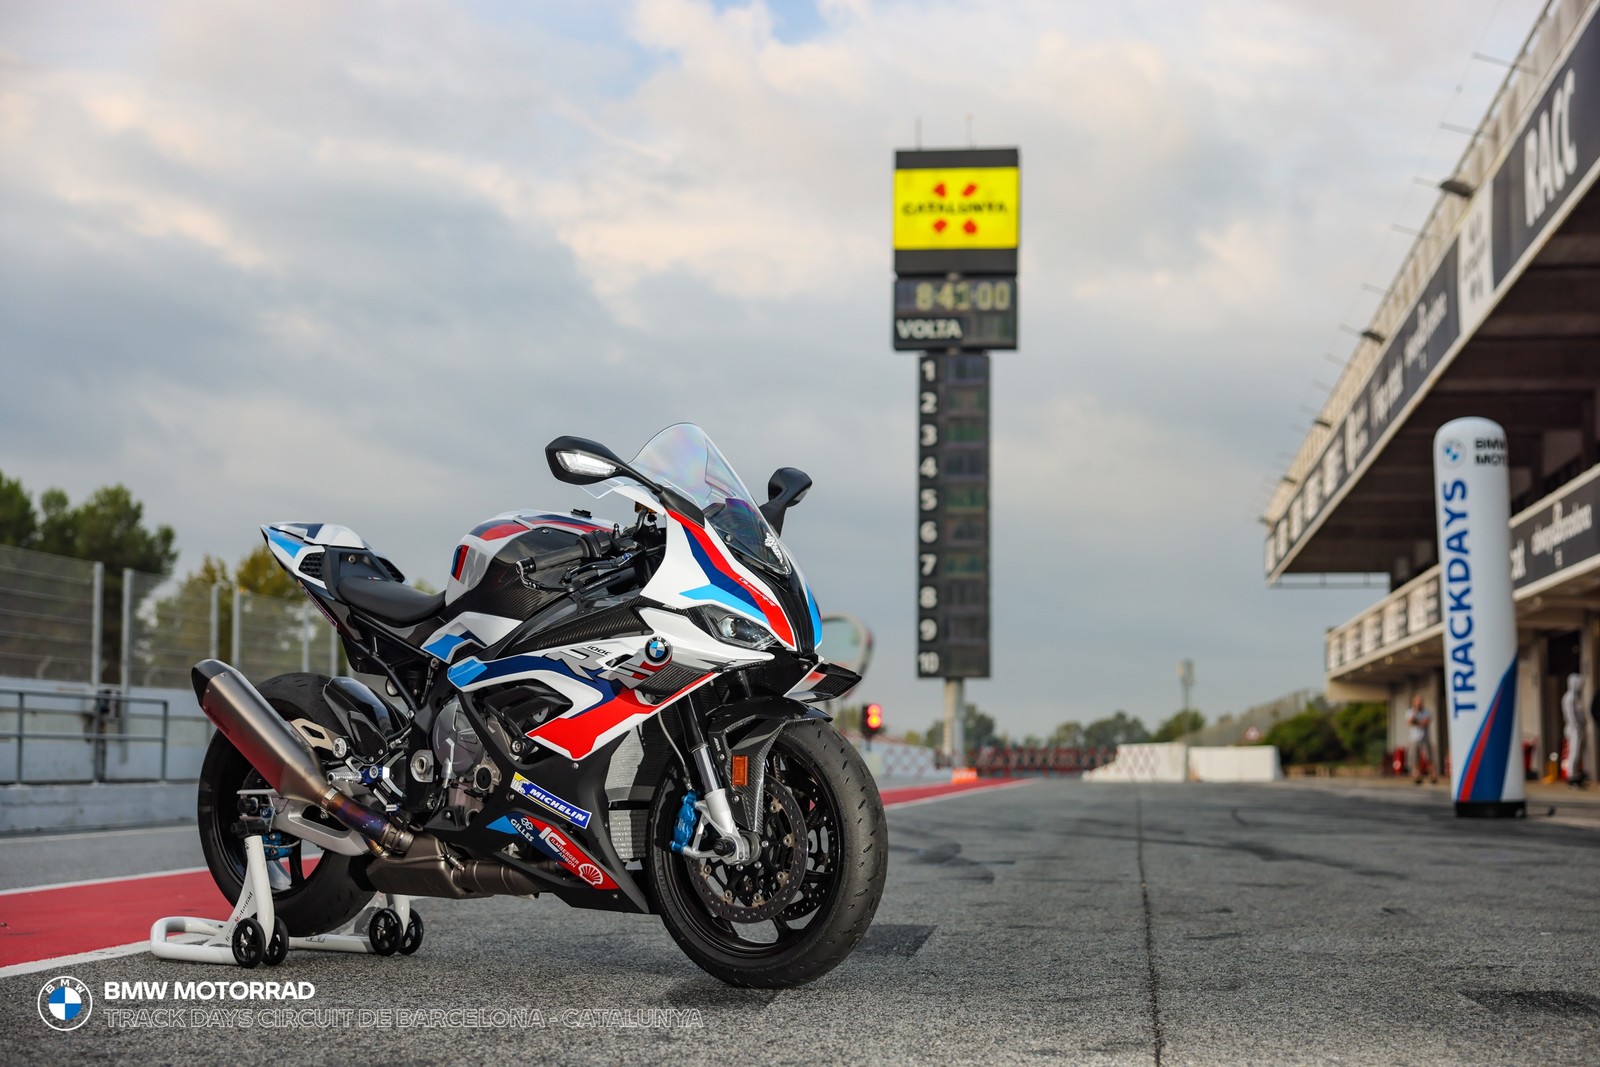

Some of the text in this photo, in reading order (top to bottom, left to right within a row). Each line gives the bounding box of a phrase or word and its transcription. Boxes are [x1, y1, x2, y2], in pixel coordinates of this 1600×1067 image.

[1524, 69, 1578, 228] RACC
[896, 318, 963, 339] VOLTA
[921, 360, 936, 382] 1
[920, 391, 938, 414] 2
[920, 424, 938, 447] 3
[919, 456, 938, 478] 4
[920, 488, 938, 511] 5
[919, 520, 938, 543] 6
[920, 553, 937, 576] 7
[919, 585, 938, 609] 8
[1442, 479, 1477, 719] TRACKDAYS
[919, 618, 938, 642] 9
[918, 651, 940, 674] 10
[529, 788, 587, 822] MICHELIN
[510, 818, 535, 842] GILLES
